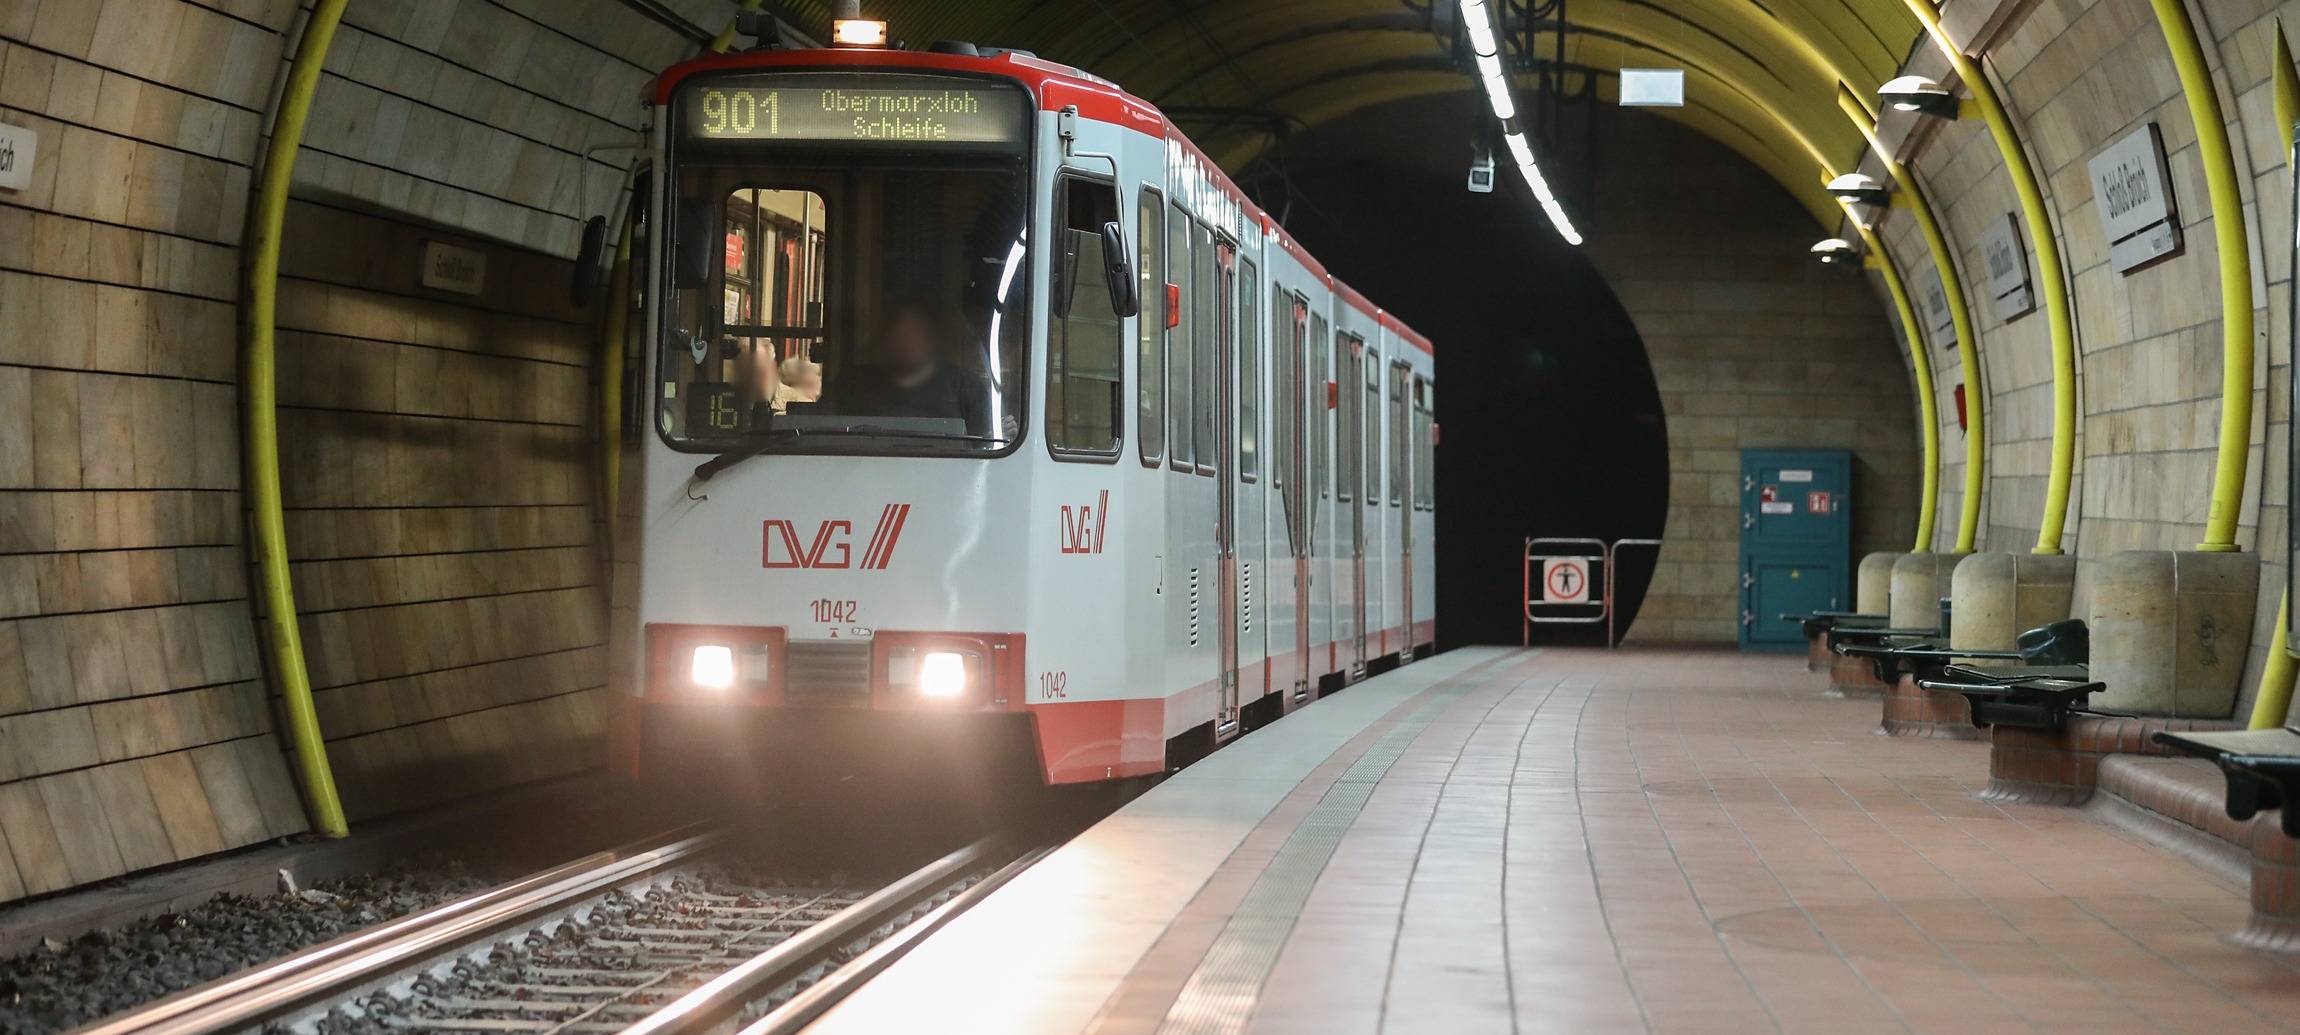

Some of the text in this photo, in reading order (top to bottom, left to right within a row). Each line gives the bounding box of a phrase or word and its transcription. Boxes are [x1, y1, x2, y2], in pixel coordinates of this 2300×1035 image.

[703, 90, 779, 134] 901
[821, 89, 978, 113] Obermarxloh
[852, 116, 947, 140] Schleife
[709, 391, 738, 429] 16
[762, 519, 852, 569] DVG
[810, 599, 857, 624] 1042
[1039, 671, 1068, 699] 1042
